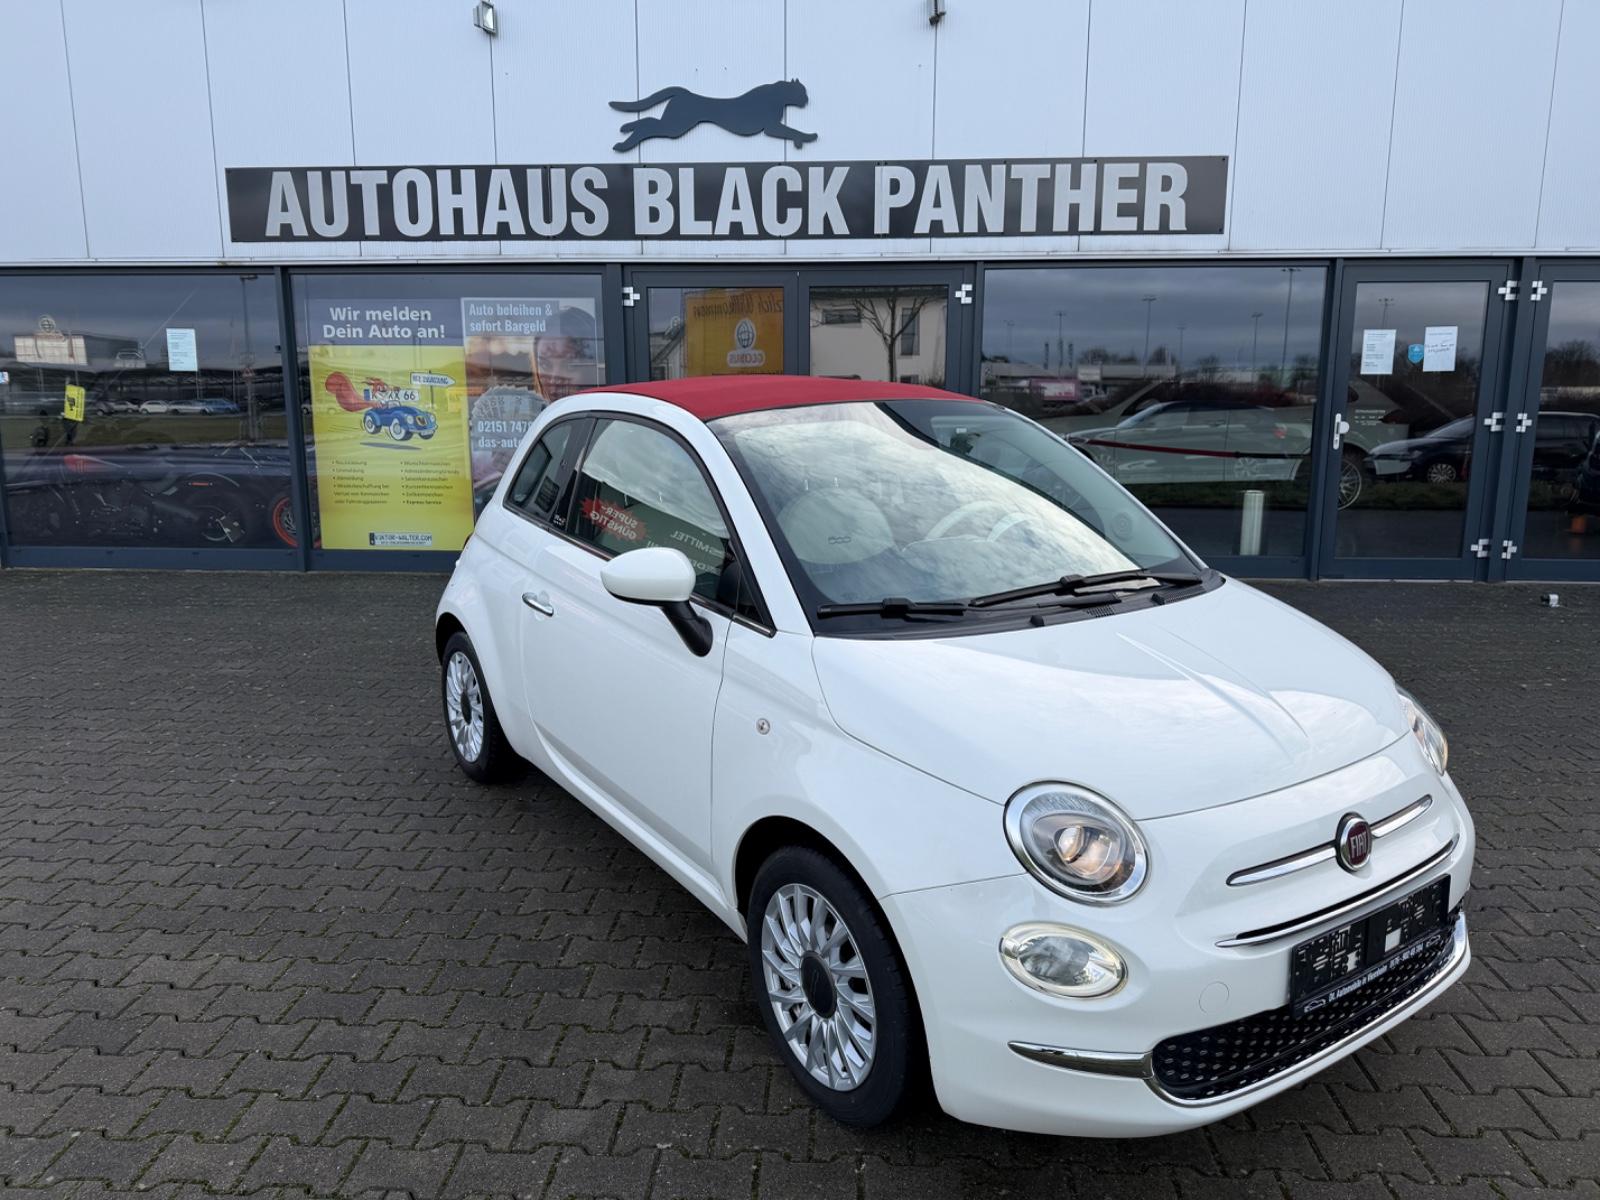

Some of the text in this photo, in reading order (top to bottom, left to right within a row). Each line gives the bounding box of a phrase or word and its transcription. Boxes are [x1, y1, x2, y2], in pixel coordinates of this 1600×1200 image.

[265, 162, 1189, 237] AUTOHAUS BLACK PANTHER
[329, 306, 432, 321] Wir melden
[469, 303, 553, 317] Auto beleihen &
[322, 324, 446, 339] Dein Auto an!
[470, 320, 546, 335] sofort Bargeld
[403, 390, 416, 401] 66
[477, 420, 508, 433] 02151
[478, 436, 521, 448] das-aut
[1350, 831, 1367, 858] FIAT
